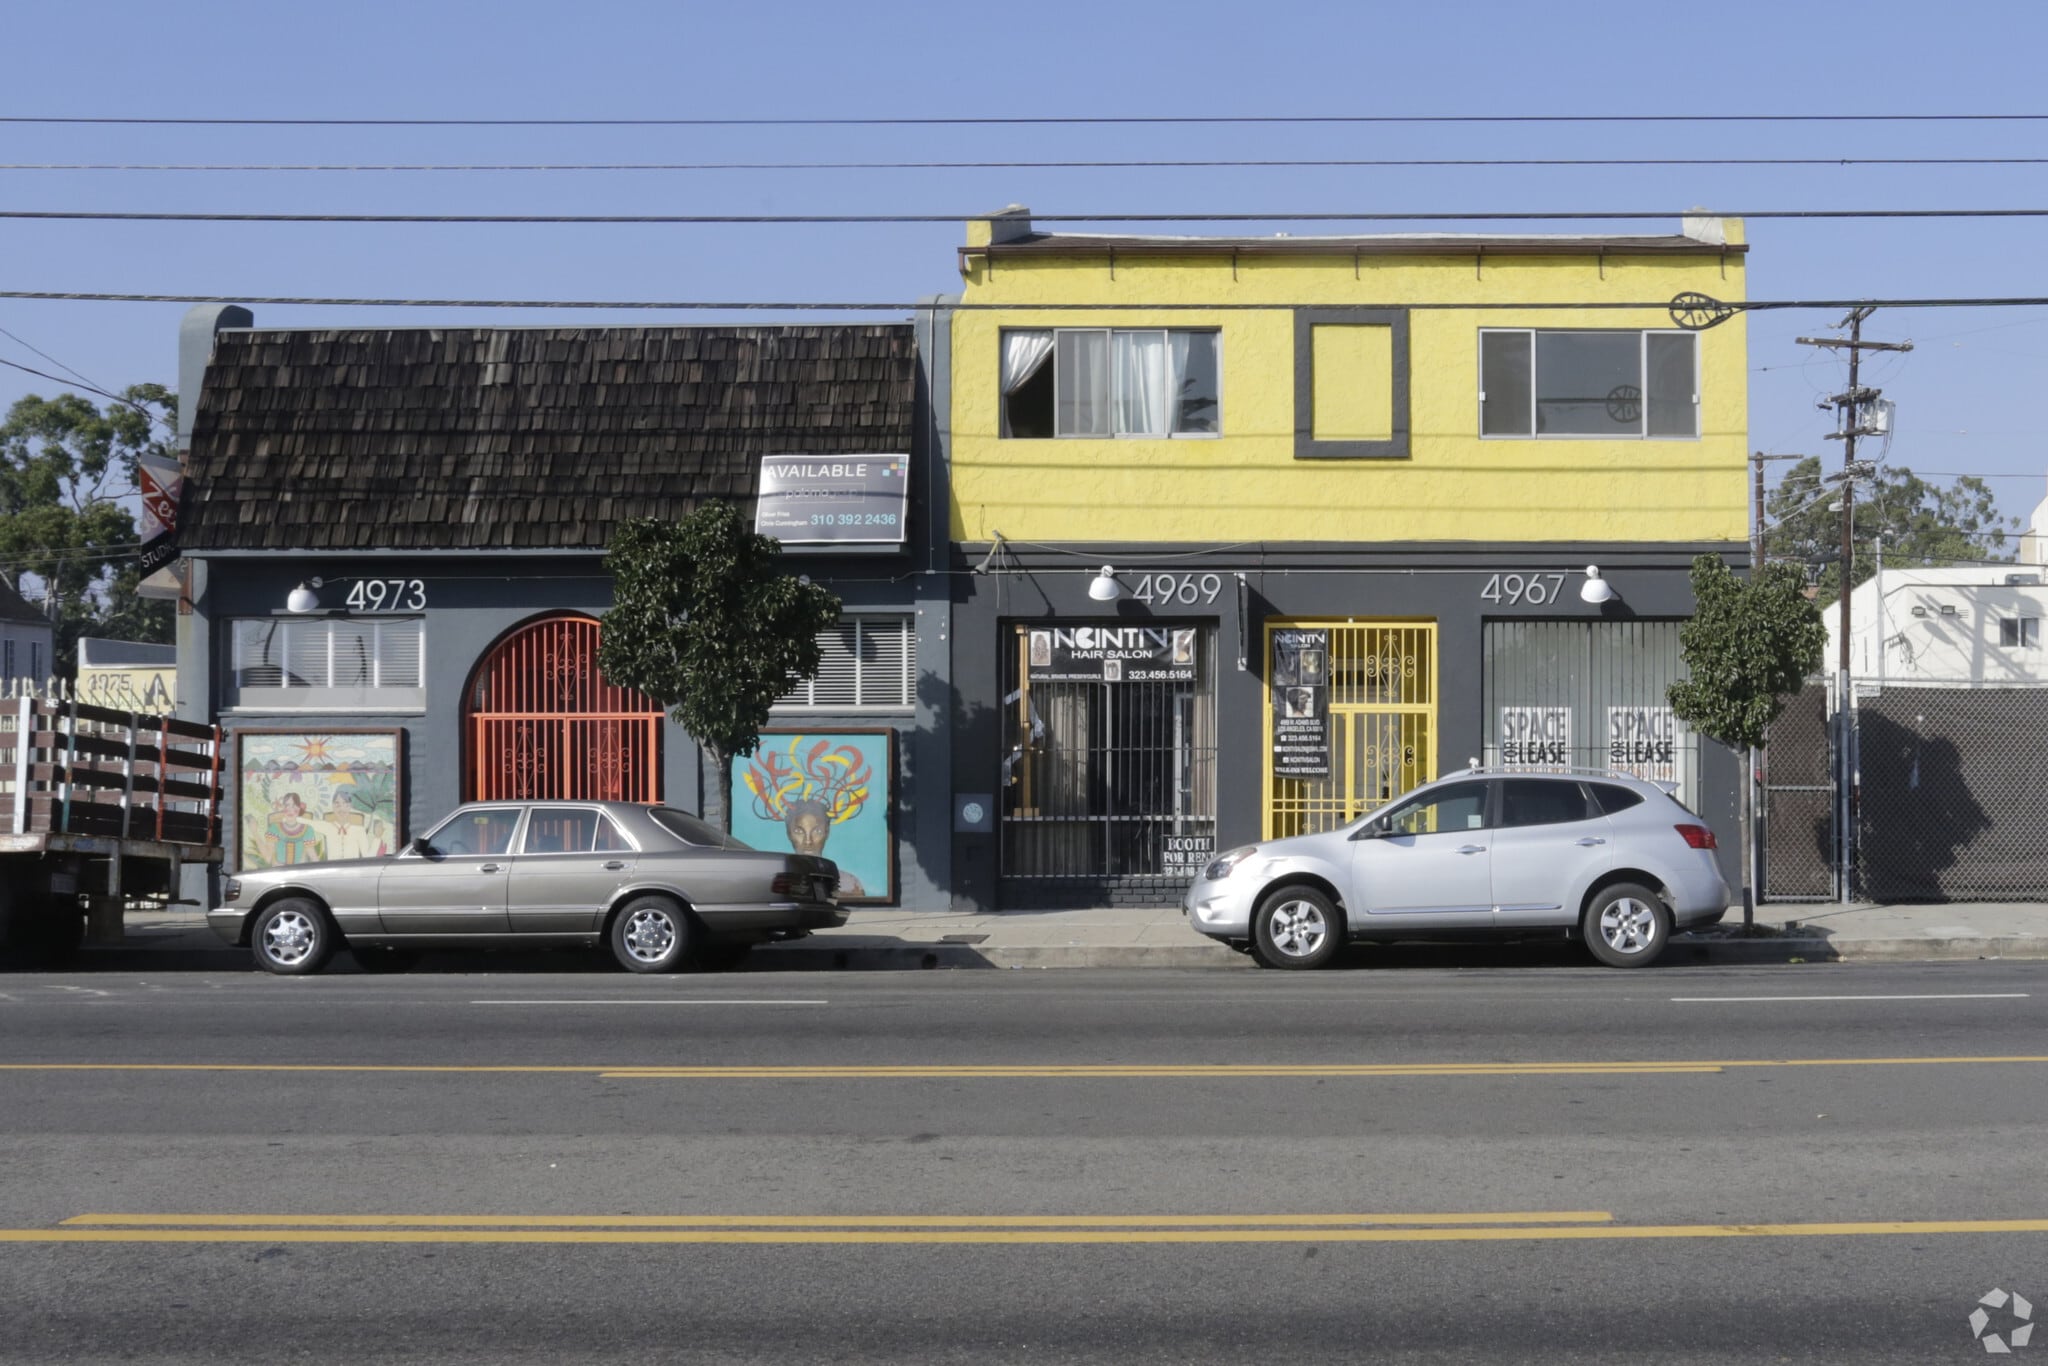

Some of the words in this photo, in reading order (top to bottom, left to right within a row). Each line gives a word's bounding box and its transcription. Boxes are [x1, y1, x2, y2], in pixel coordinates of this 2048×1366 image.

[767, 463, 867, 478] AVAILABLE
[811, 514, 834, 526] 310
[838, 514, 861, 526] 392
[865, 513, 896, 526] 2436
[345, 579, 427, 611] 4973
[1133, 573, 1222, 605] 4969
[1480, 573, 1566, 605] 4967
[1071, 650, 1103, 659] HAIR
[1106, 650, 1153, 659] SALON
[1128, 670, 1192, 680] 323.456.5164
[1503, 711, 1566, 740] SPACE
[1611, 711, 1674, 740] SPACE
[1504, 742, 1519, 764] FOR
[1519, 742, 1566, 764] LEASE
[1611, 742, 1626, 764] FOR
[1626, 742, 1674, 764] LEASE
[1168, 838, 1210, 851] BOOTH
[1163, 852, 1184, 863] FOR
